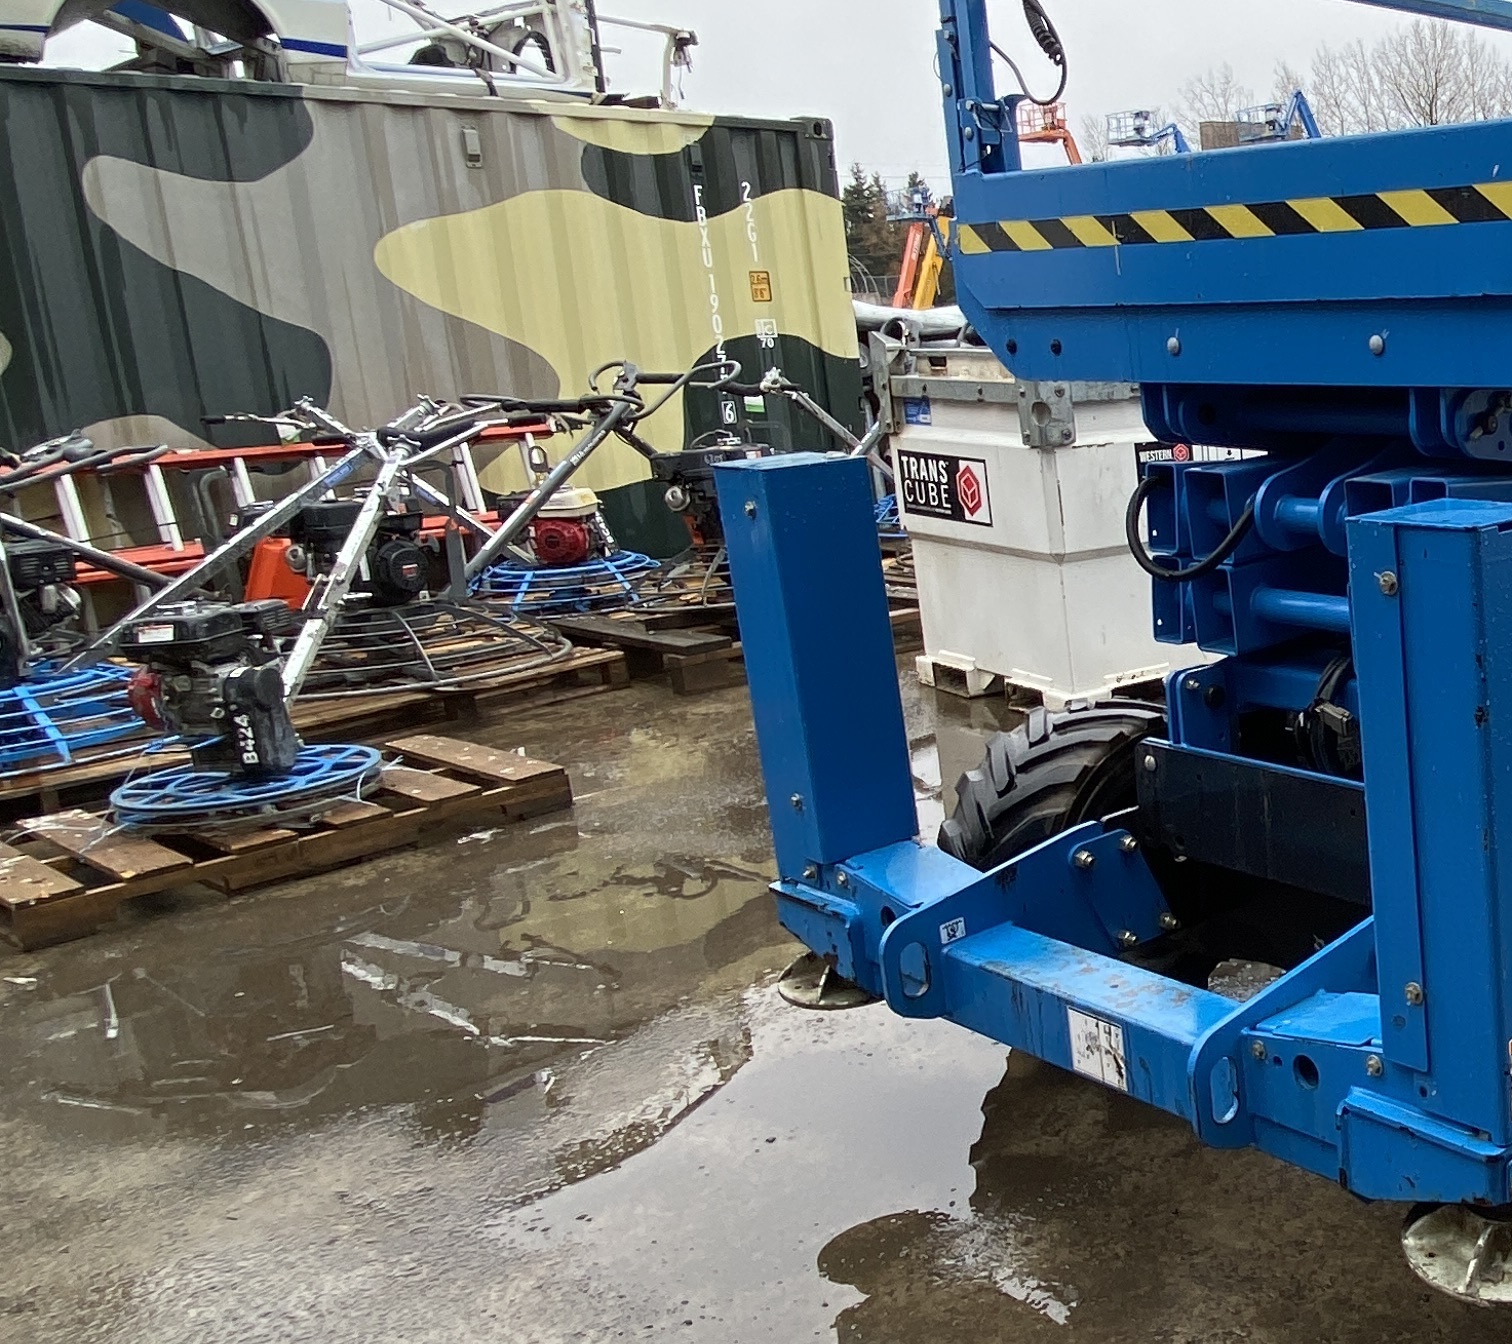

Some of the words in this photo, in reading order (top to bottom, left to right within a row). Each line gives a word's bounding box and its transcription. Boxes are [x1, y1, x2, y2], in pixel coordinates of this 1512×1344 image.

[900, 455, 948, 484] TRANS
[1138, 448, 1173, 463] WESTERN
[904, 479, 952, 508] CUBE
